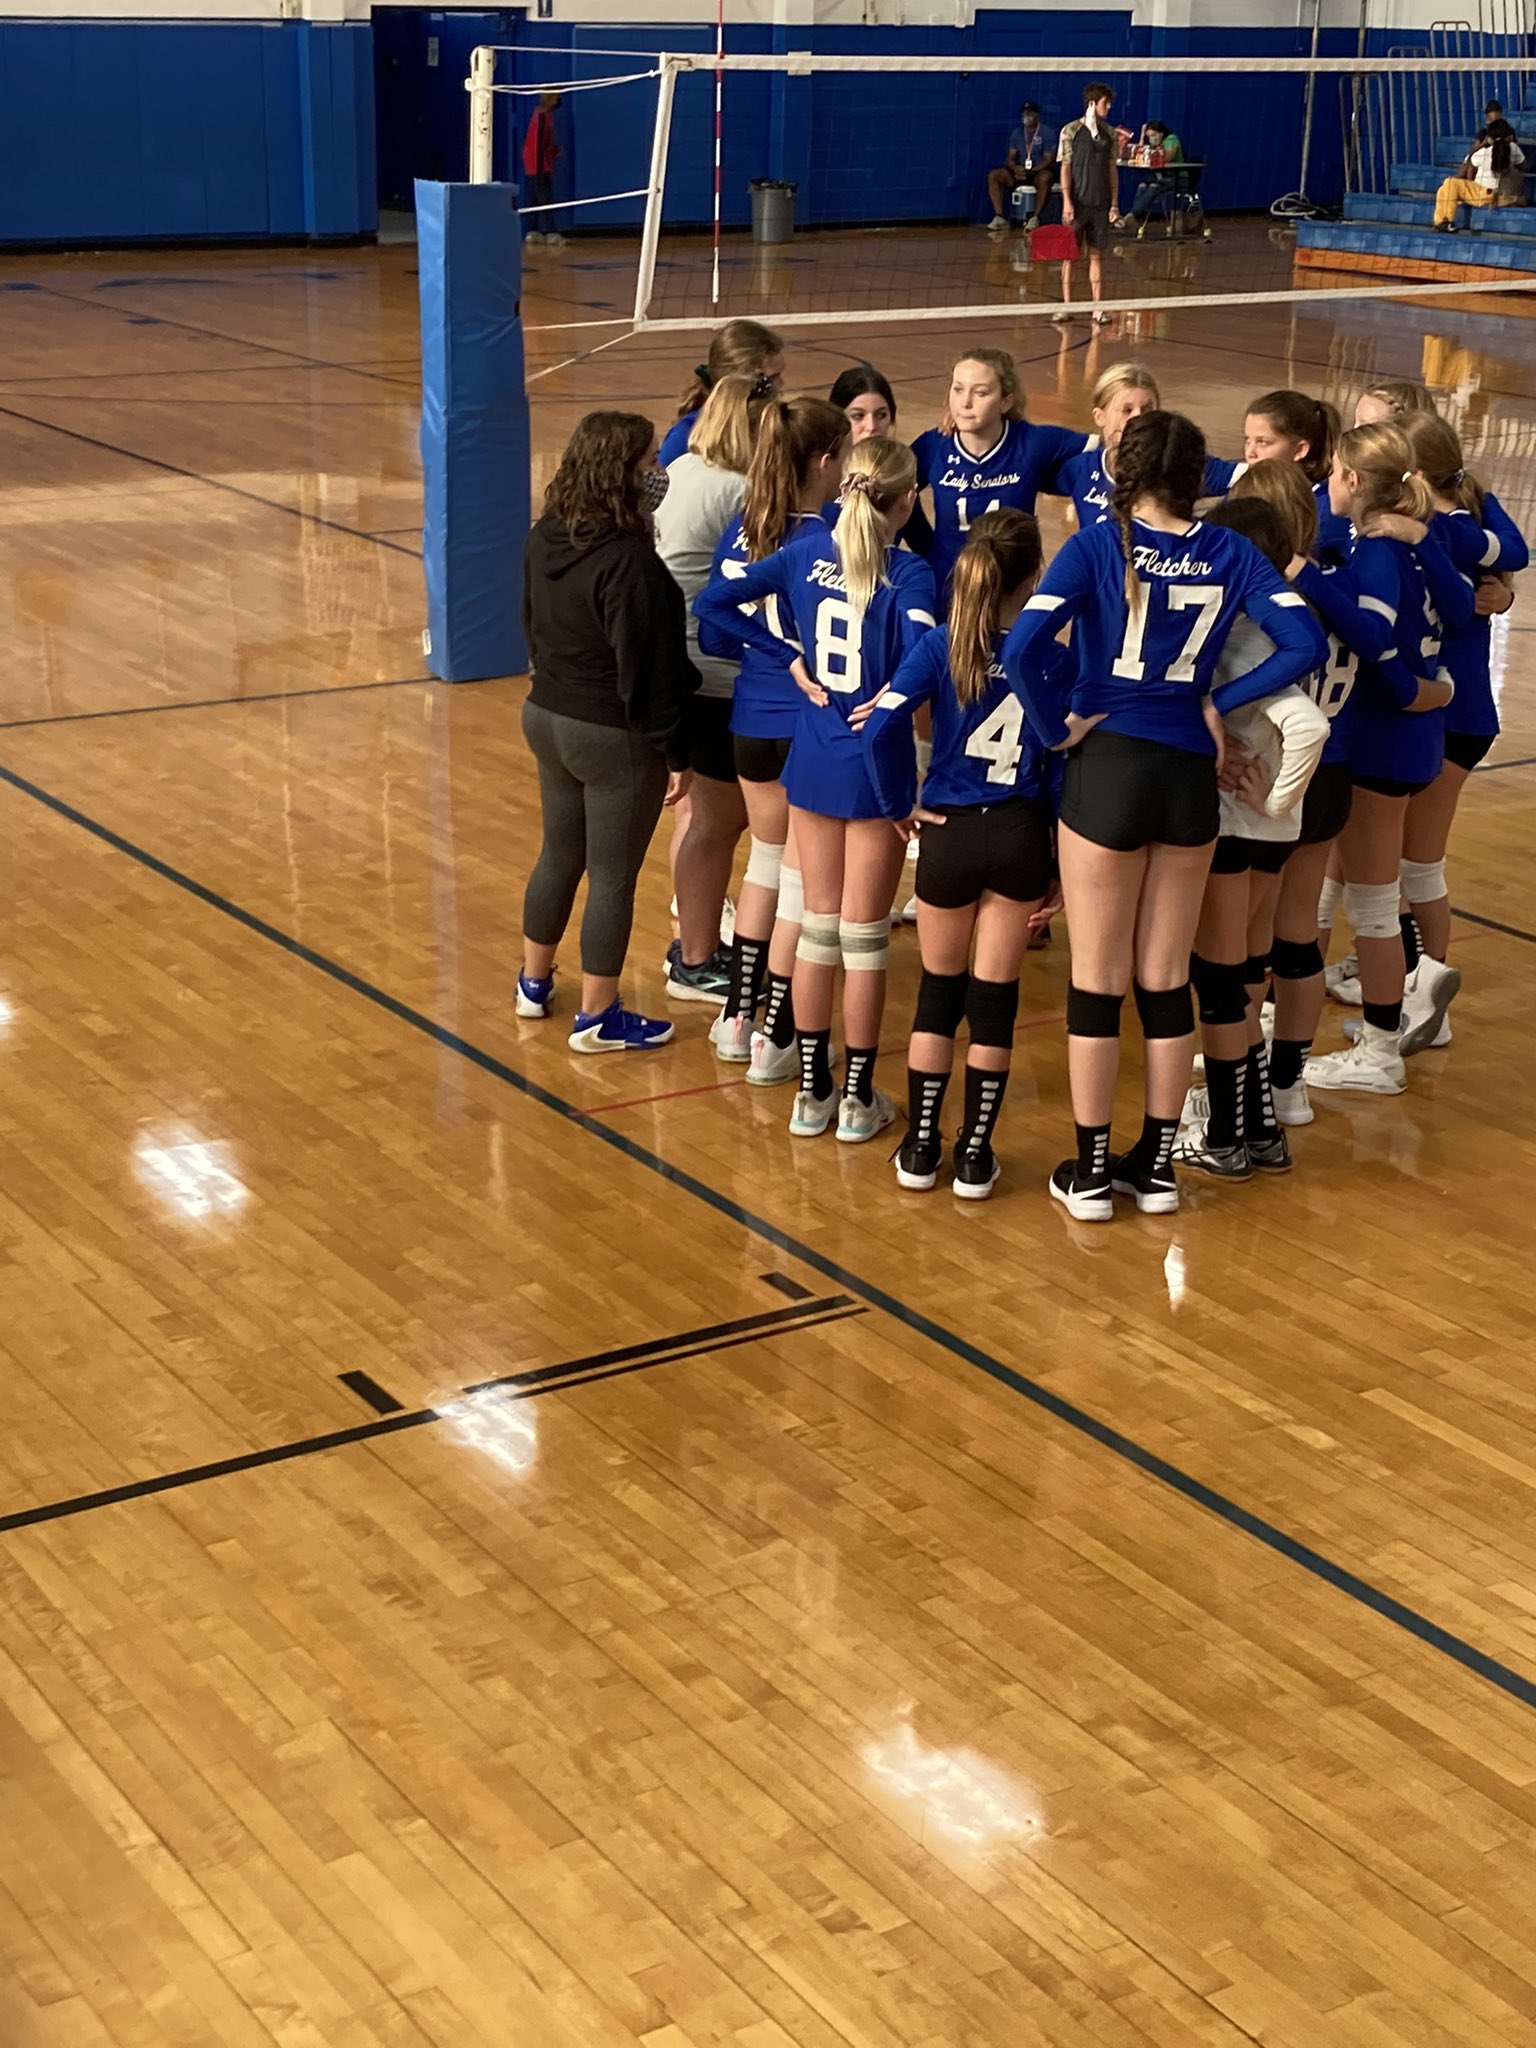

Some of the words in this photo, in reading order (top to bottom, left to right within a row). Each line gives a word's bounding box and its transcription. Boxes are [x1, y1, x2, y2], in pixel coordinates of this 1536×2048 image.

[938, 469, 969, 492] Lady
[971, 473, 1021, 489] Senators
[1132, 545, 1213, 577] Fletcher
[815, 597, 863, 694] 8
[1111, 582, 1224, 683] 17
[964, 692, 1025, 786] 4
